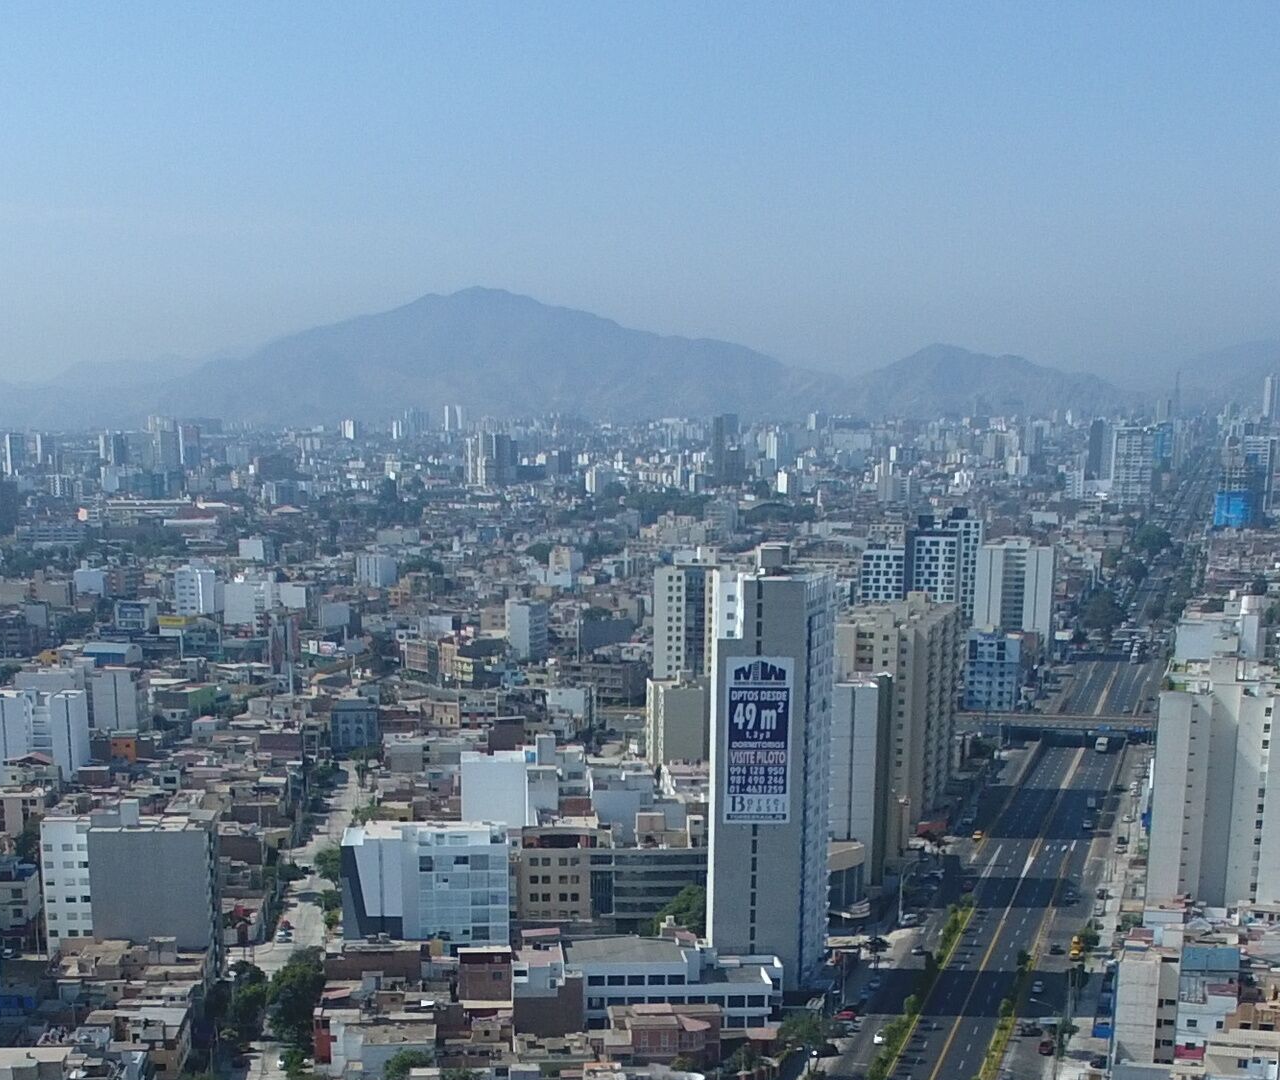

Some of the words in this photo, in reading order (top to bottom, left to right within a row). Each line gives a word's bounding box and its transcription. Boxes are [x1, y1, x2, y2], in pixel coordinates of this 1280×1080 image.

[731, 690, 758, 701] DPTOS
[760, 690, 787, 701] DESDE
[733, 702, 757, 730] 49
[730, 751, 755, 764] VISITE
[757, 751, 786, 764] PILOTO
[749, 766, 765, 775] 128
[767, 766, 785, 775] 950
